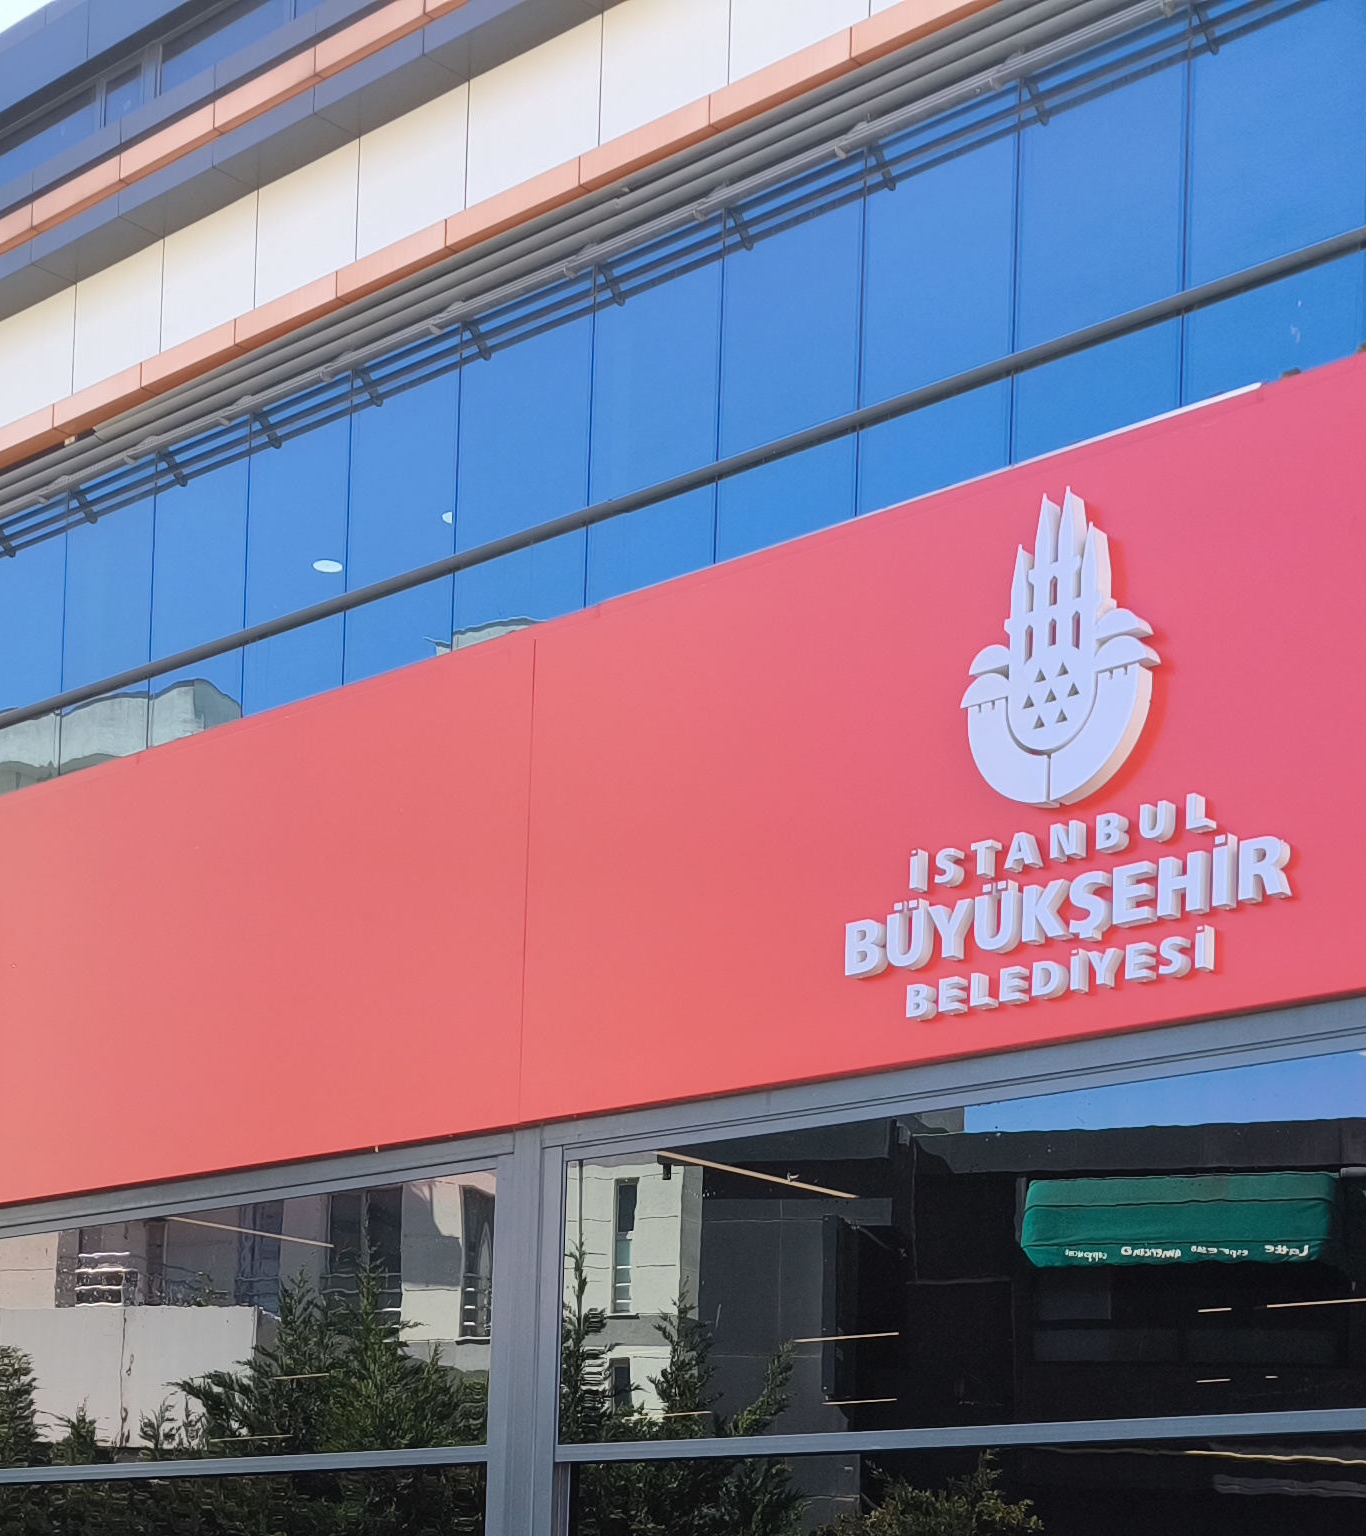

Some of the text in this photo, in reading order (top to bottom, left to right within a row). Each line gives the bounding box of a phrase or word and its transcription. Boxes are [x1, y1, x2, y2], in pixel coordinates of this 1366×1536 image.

[909, 792, 1217, 893] İSTANBUL
[844, 832, 1293, 979] BÜYÜKŞEHİR
[905, 924, 1216, 1021] BELEDİYESİ
